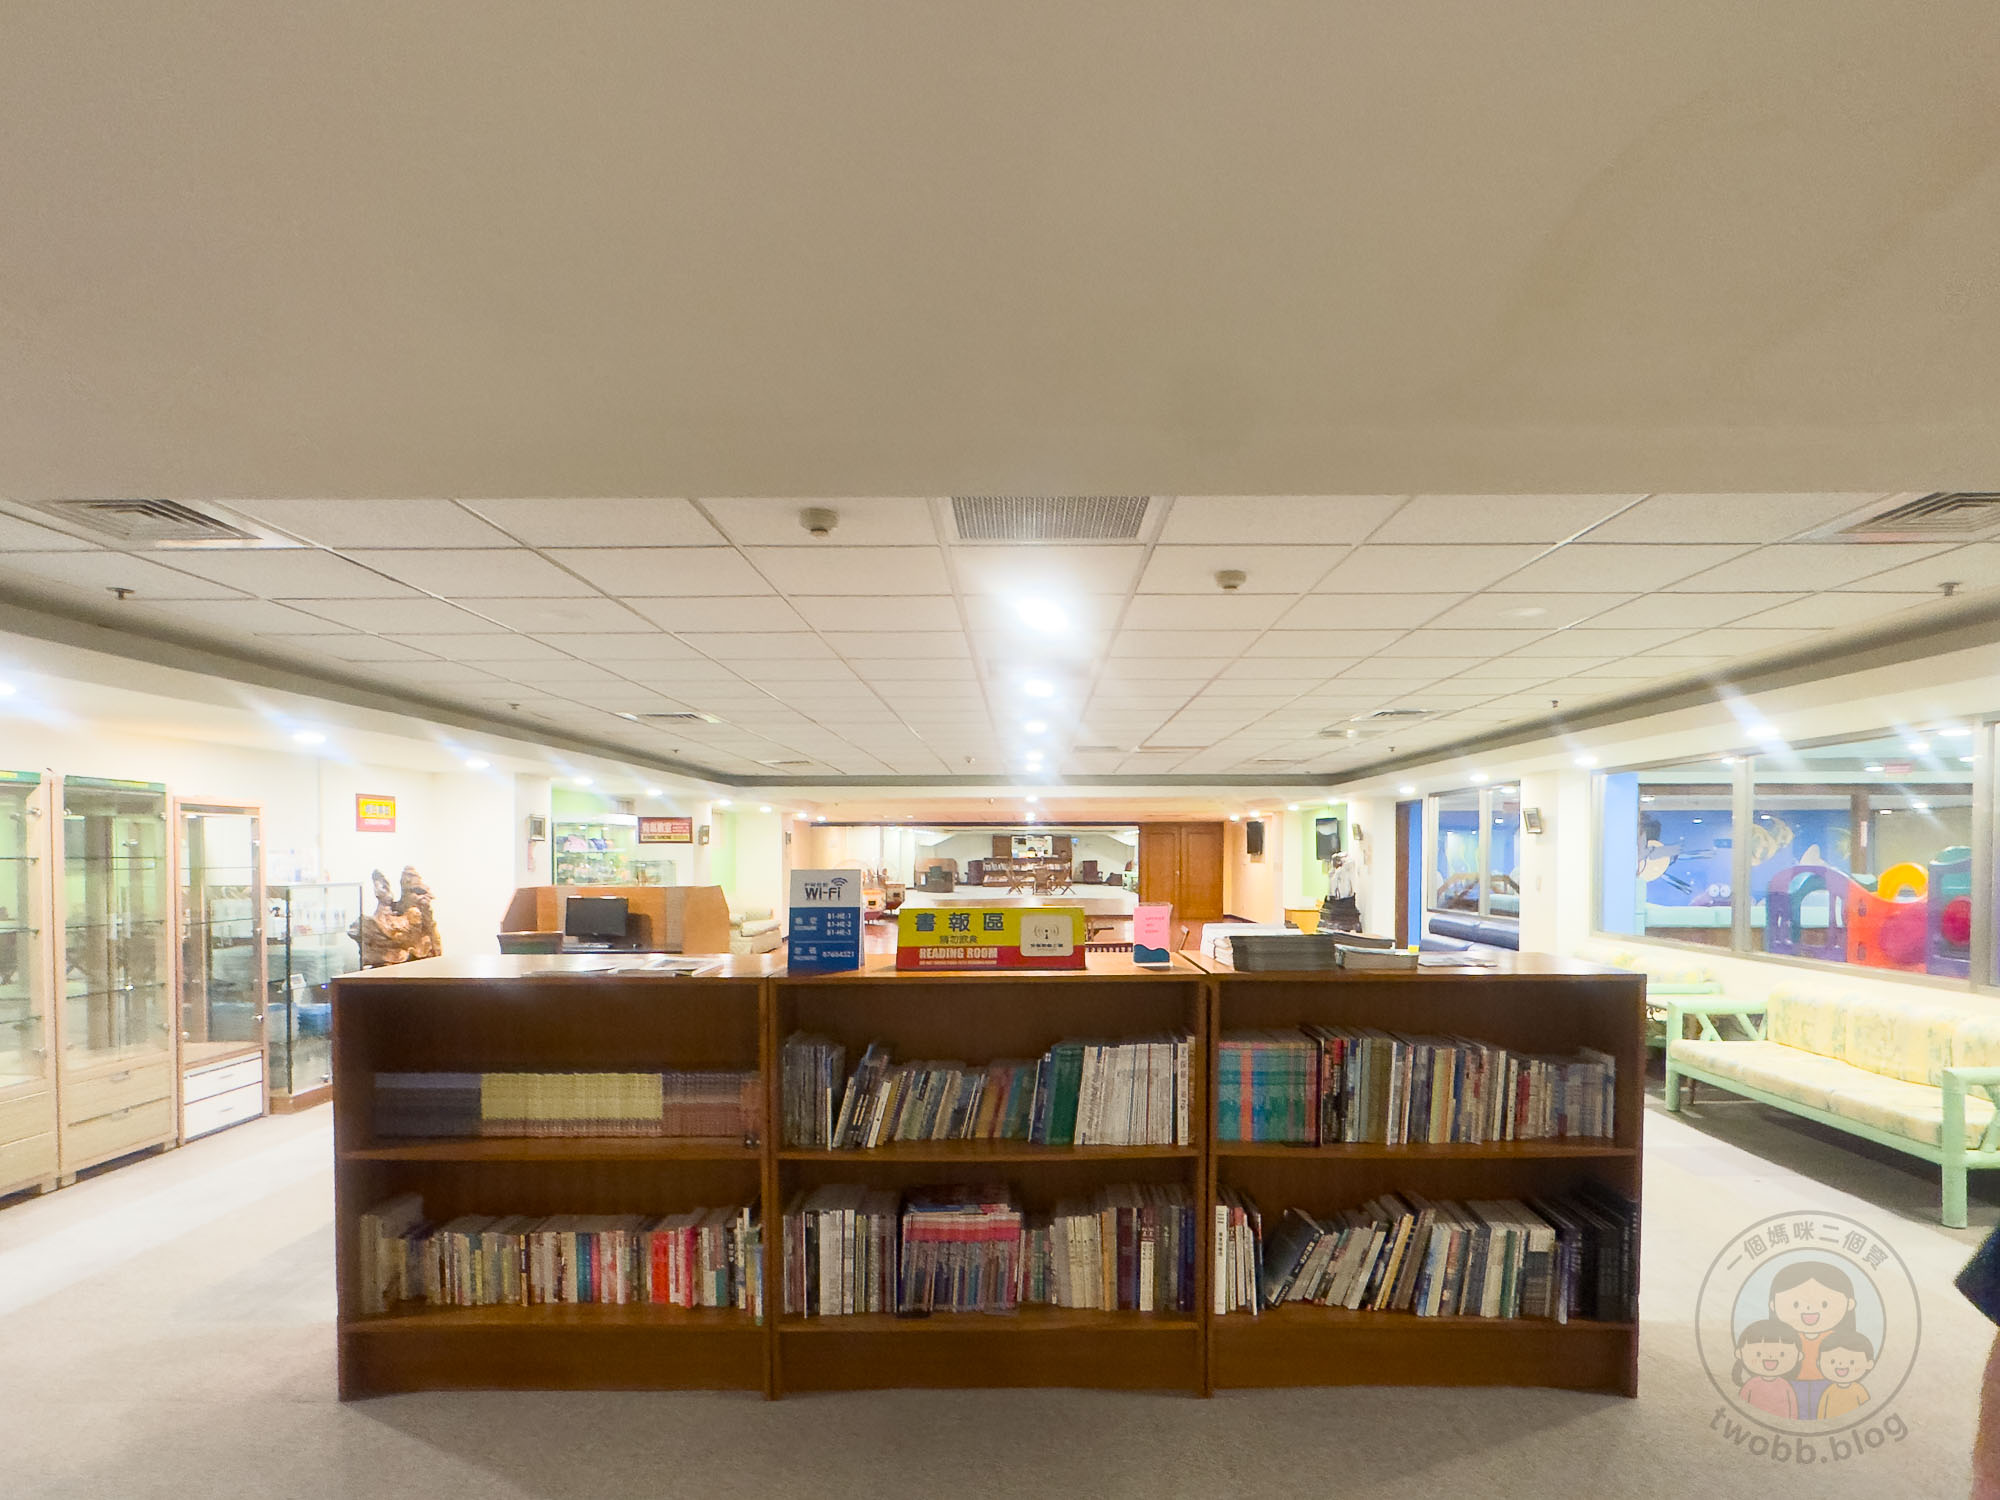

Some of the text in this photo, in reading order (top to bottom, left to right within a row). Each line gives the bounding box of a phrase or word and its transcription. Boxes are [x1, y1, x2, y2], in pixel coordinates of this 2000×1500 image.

[914, 912, 1004, 932] 書報區
[919, 947, 998, 959] READING ROOM
